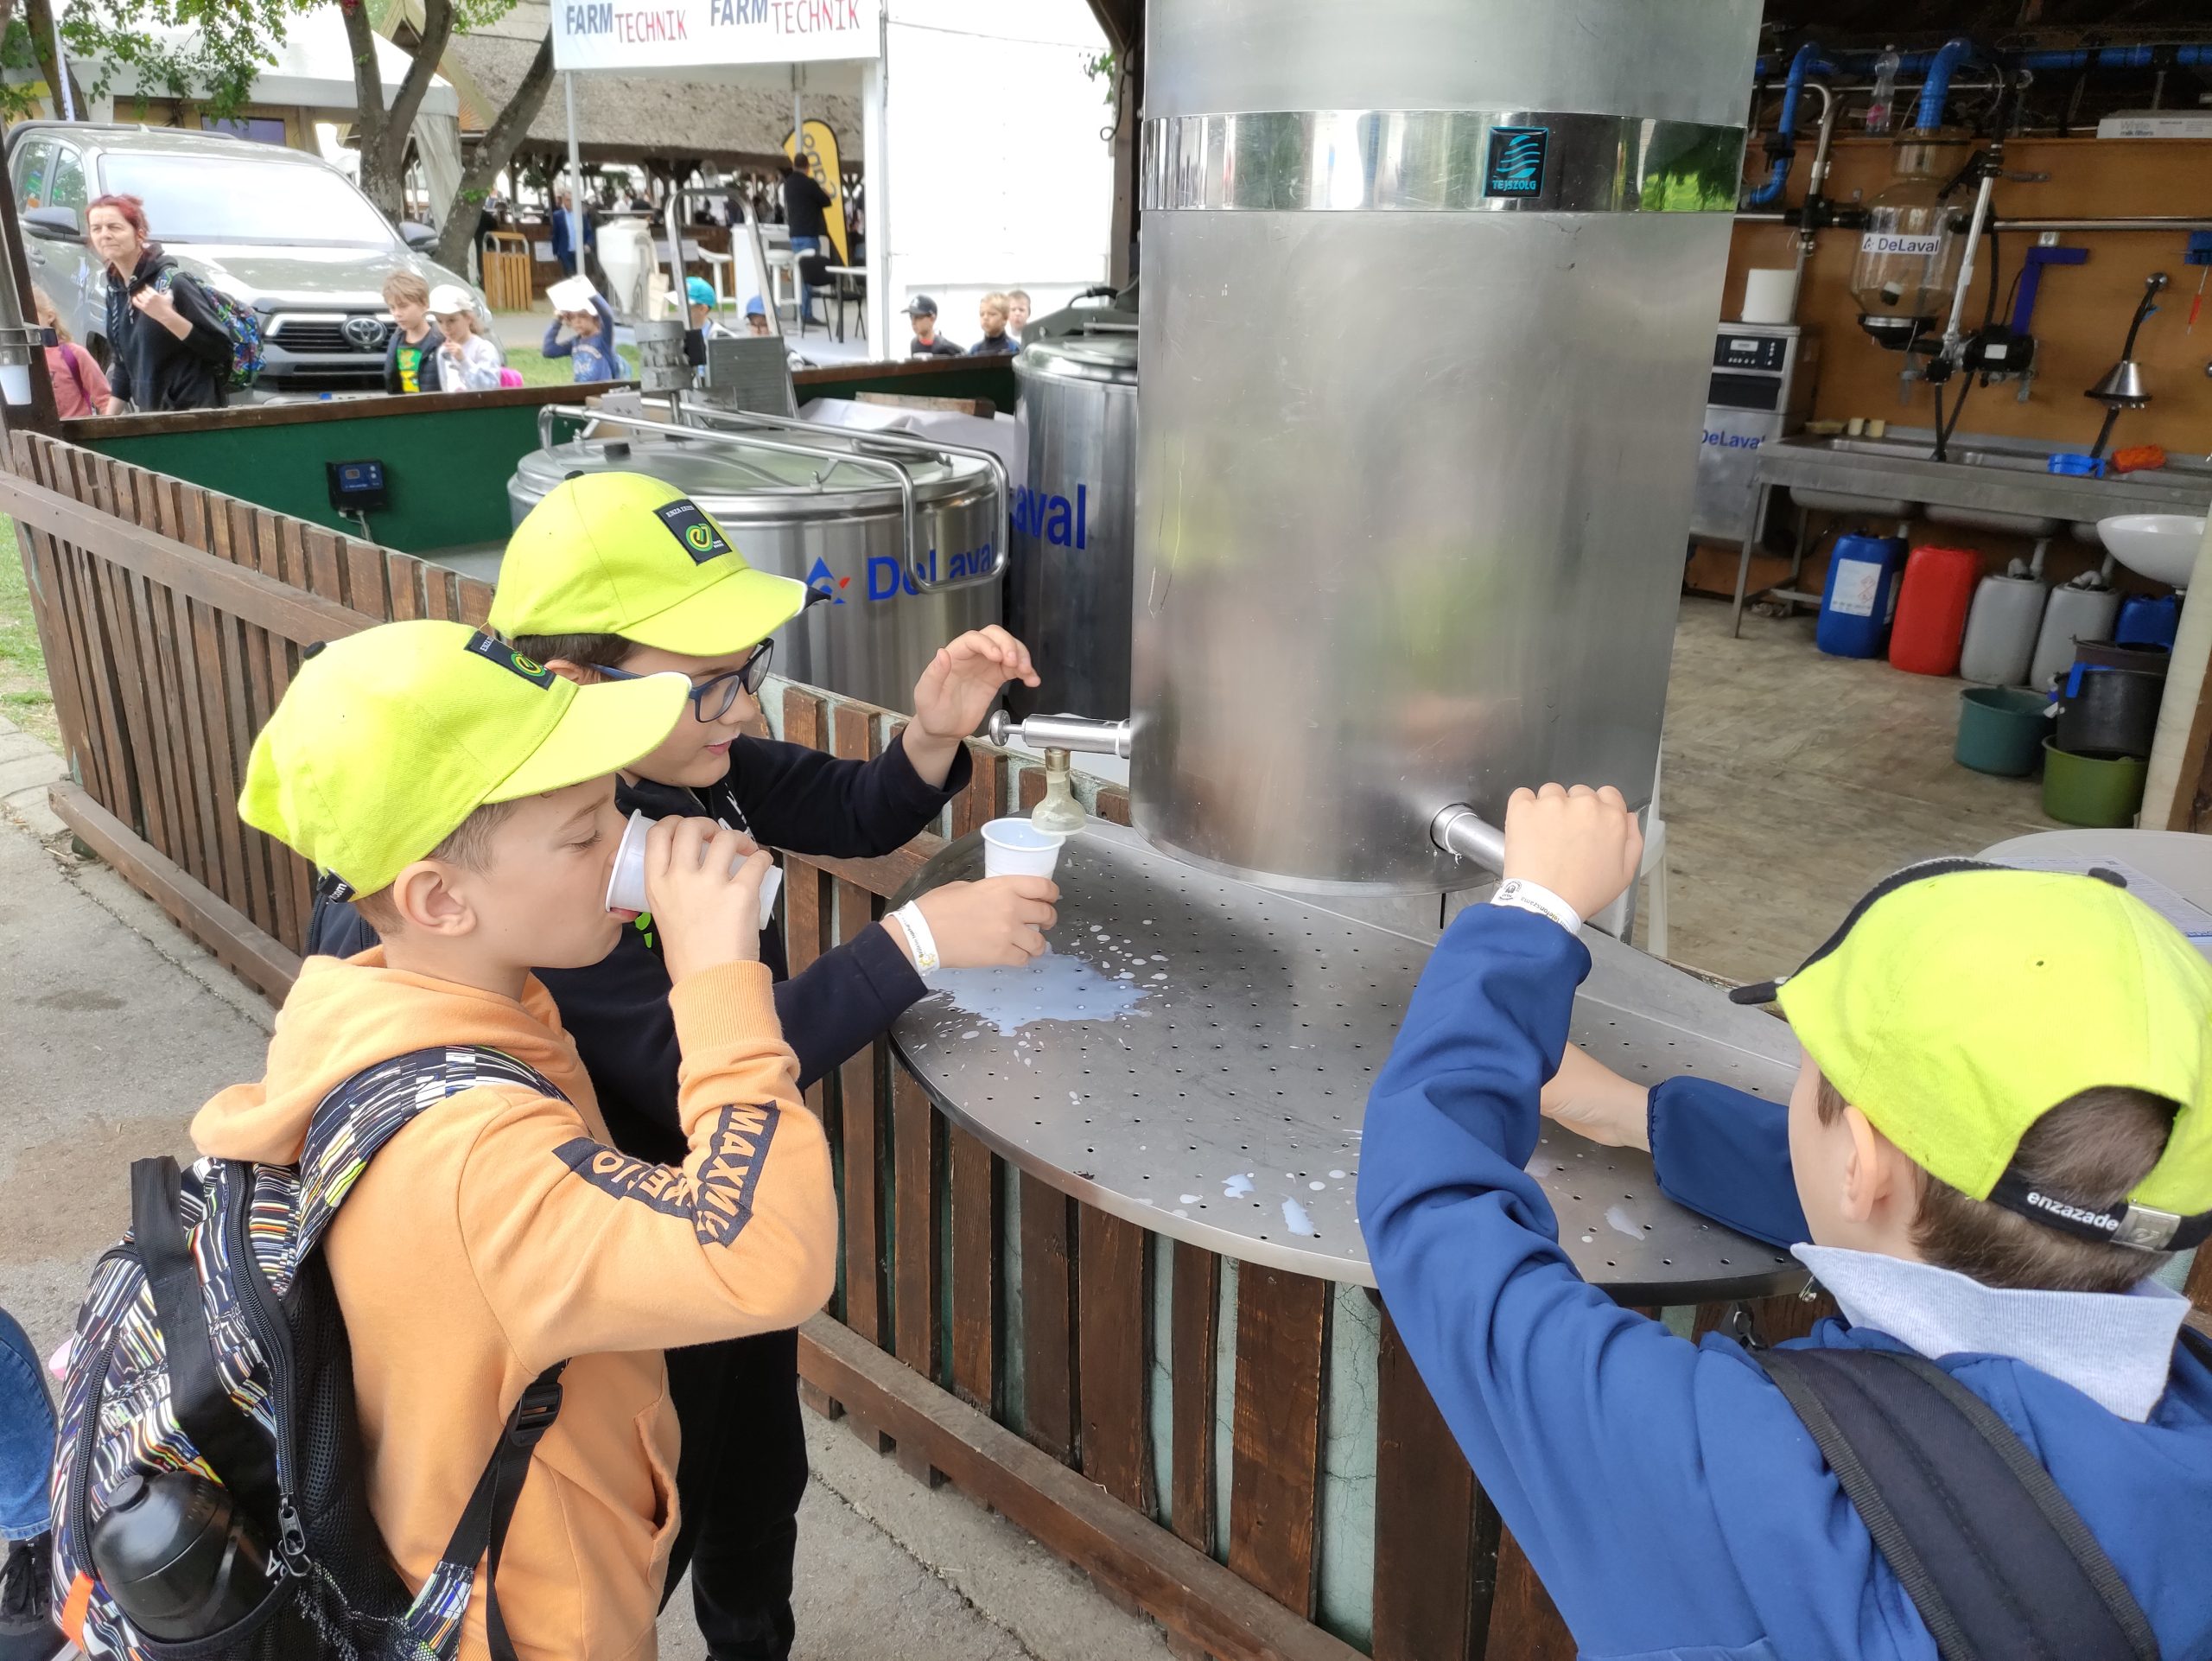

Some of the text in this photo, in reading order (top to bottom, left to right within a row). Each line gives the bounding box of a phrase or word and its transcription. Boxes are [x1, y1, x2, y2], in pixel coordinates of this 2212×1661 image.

[1492, 180, 1536, 191] TEJSZOLG
[1878, 238, 1939, 252] DeLaval
[1009, 482, 1086, 550] aval
